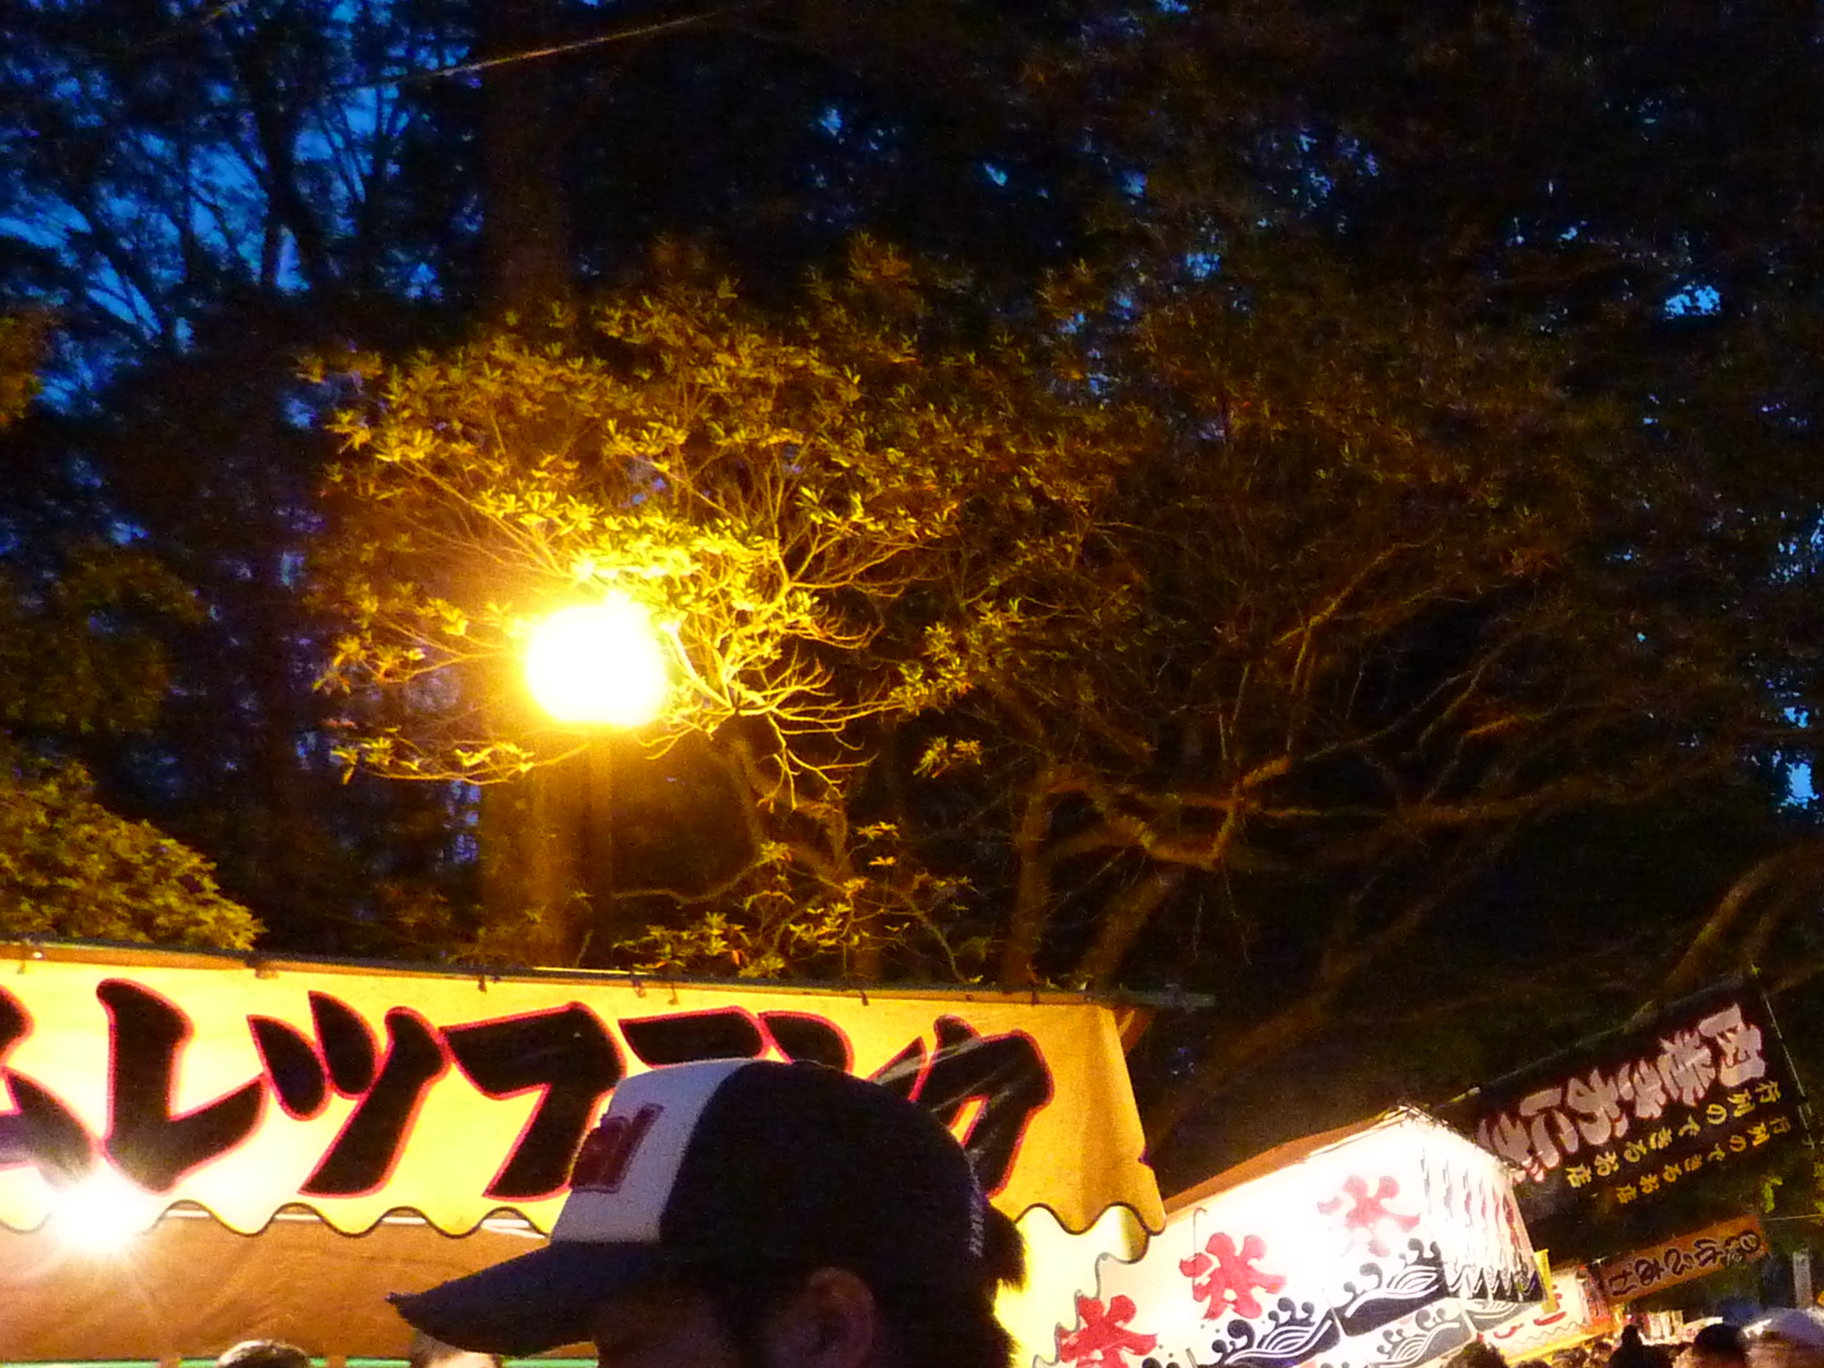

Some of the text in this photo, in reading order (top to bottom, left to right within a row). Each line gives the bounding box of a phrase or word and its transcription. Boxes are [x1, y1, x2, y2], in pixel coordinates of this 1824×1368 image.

[1566, 1079, 1782, 1189] 行列のできるお店
[1616, 1115, 1791, 1205] 行列のできるお店
[1179, 1231, 1288, 1320] 氷
